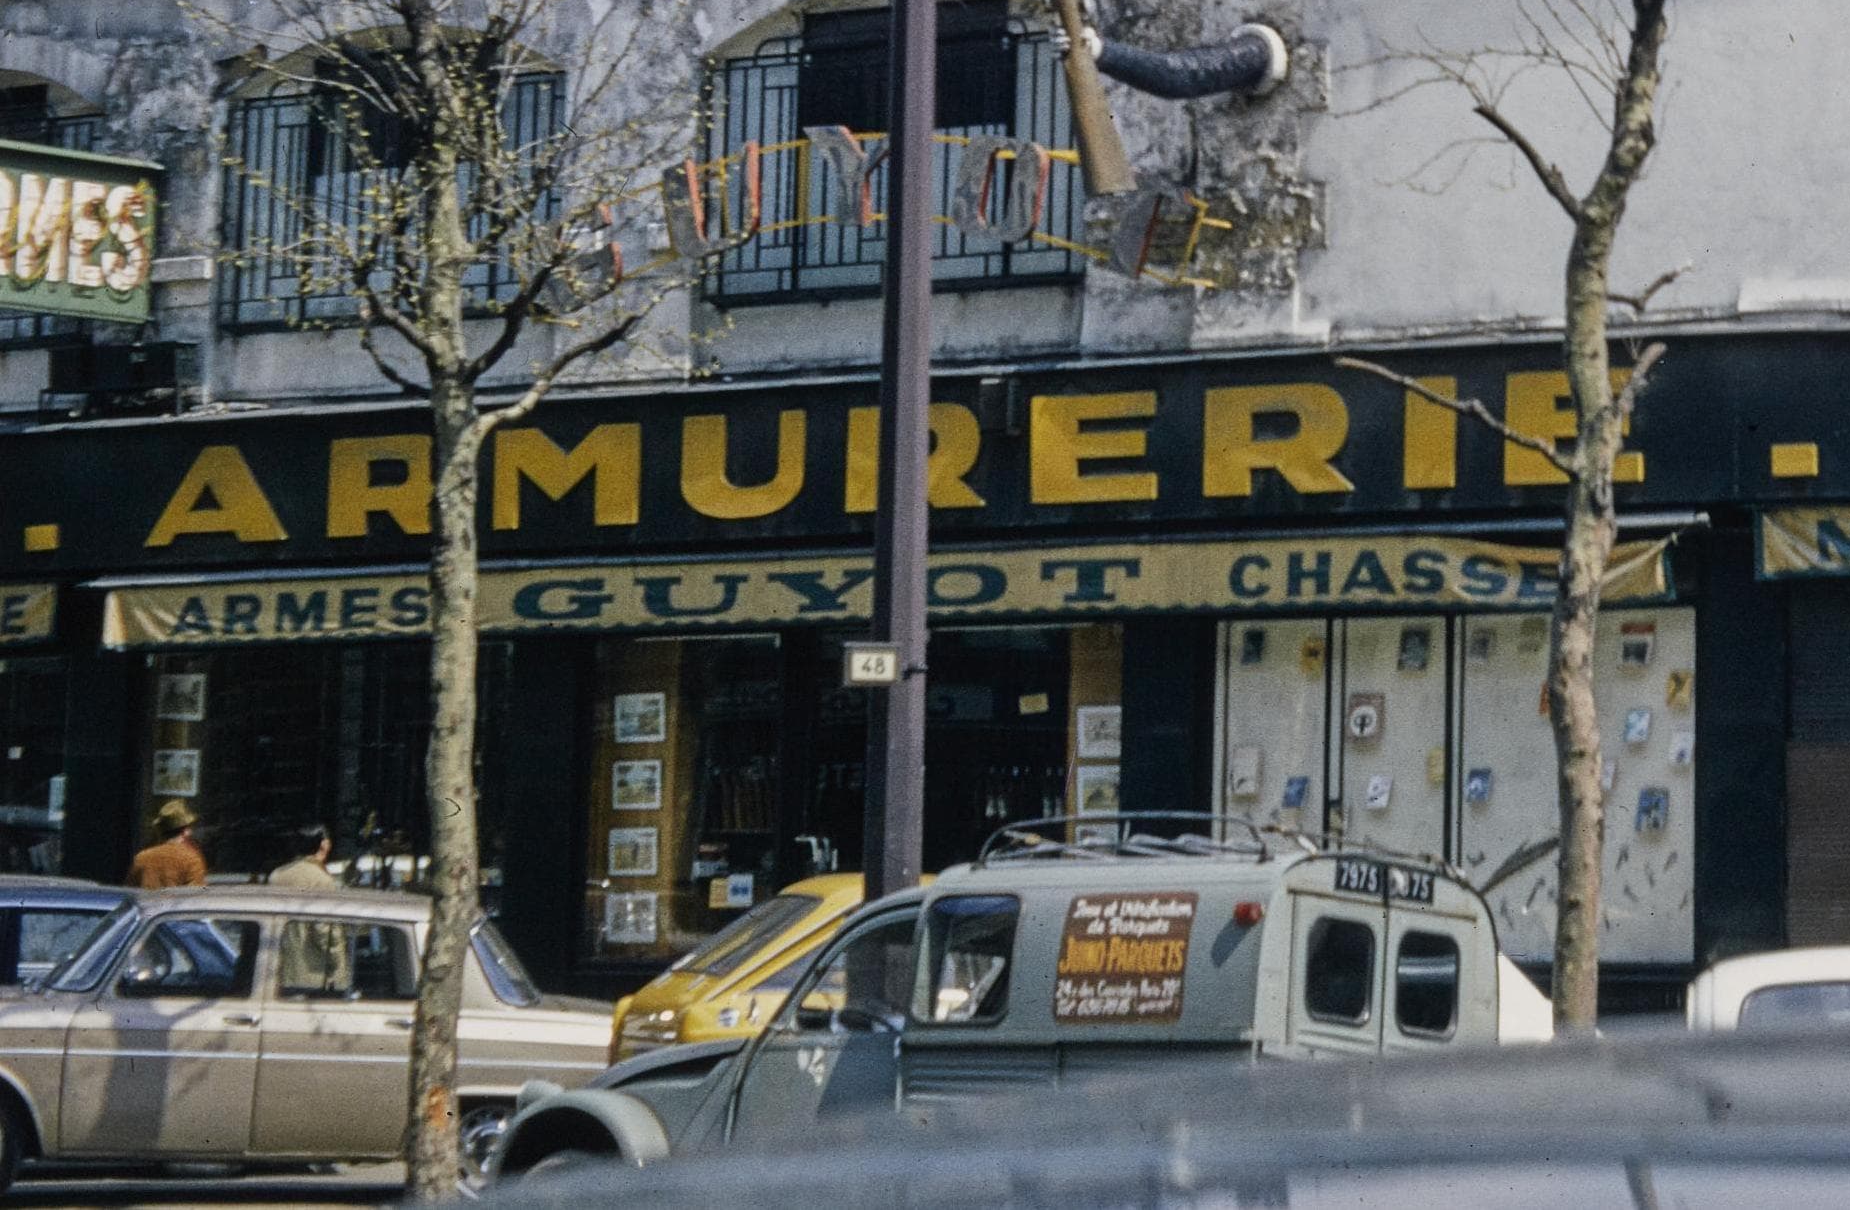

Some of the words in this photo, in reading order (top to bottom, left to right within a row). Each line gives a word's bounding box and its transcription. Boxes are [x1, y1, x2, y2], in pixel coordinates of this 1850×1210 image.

[0, 170, 148, 290] MES
[144, 366, 1646, 548] ARMURERIE
[171, 587, 432, 637] ARMES
[512, 557, 1141, 621] GUYOT
[862, 654, 885, 676] 48
